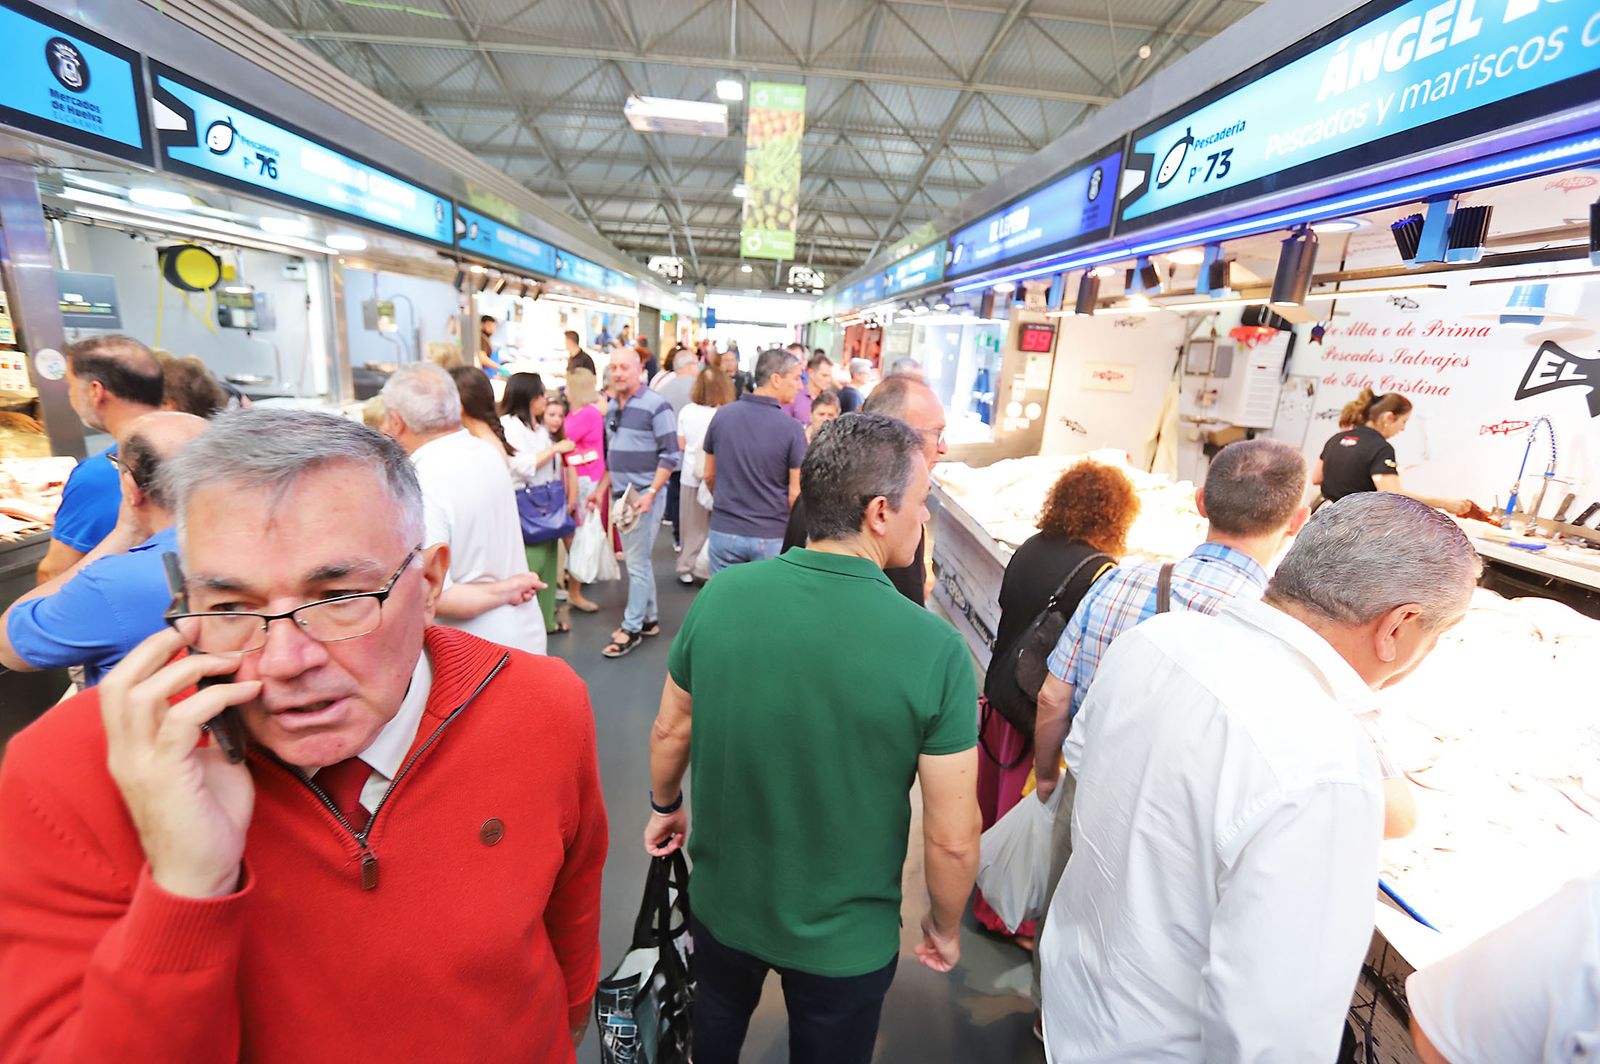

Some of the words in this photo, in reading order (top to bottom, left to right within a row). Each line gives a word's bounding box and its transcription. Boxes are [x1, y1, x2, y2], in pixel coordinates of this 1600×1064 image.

[1316, 0, 1484, 104] ÁNGEL
[49, 88, 101, 114] Mercados
[1264, 99, 1371, 161] Pescados
[1376, 91, 1395, 126] y
[1398, 25, 1569, 113] mariscos
[51, 100, 65, 112] de
[67, 104, 103, 124] Huelva
[1340, 321, 1377, 337] Alba
[1396, 322, 1416, 337] de
[1422, 319, 1491, 338] Prima
[1321, 346, 1384, 364] Pescados
[1389, 347, 1470, 373] Salvajes
[1523, 349, 1588, 390] EL
[1322, 373, 1338, 386] de
[1341, 372, 1374, 389] Isla
[1379, 375, 1451, 397] Cristina
